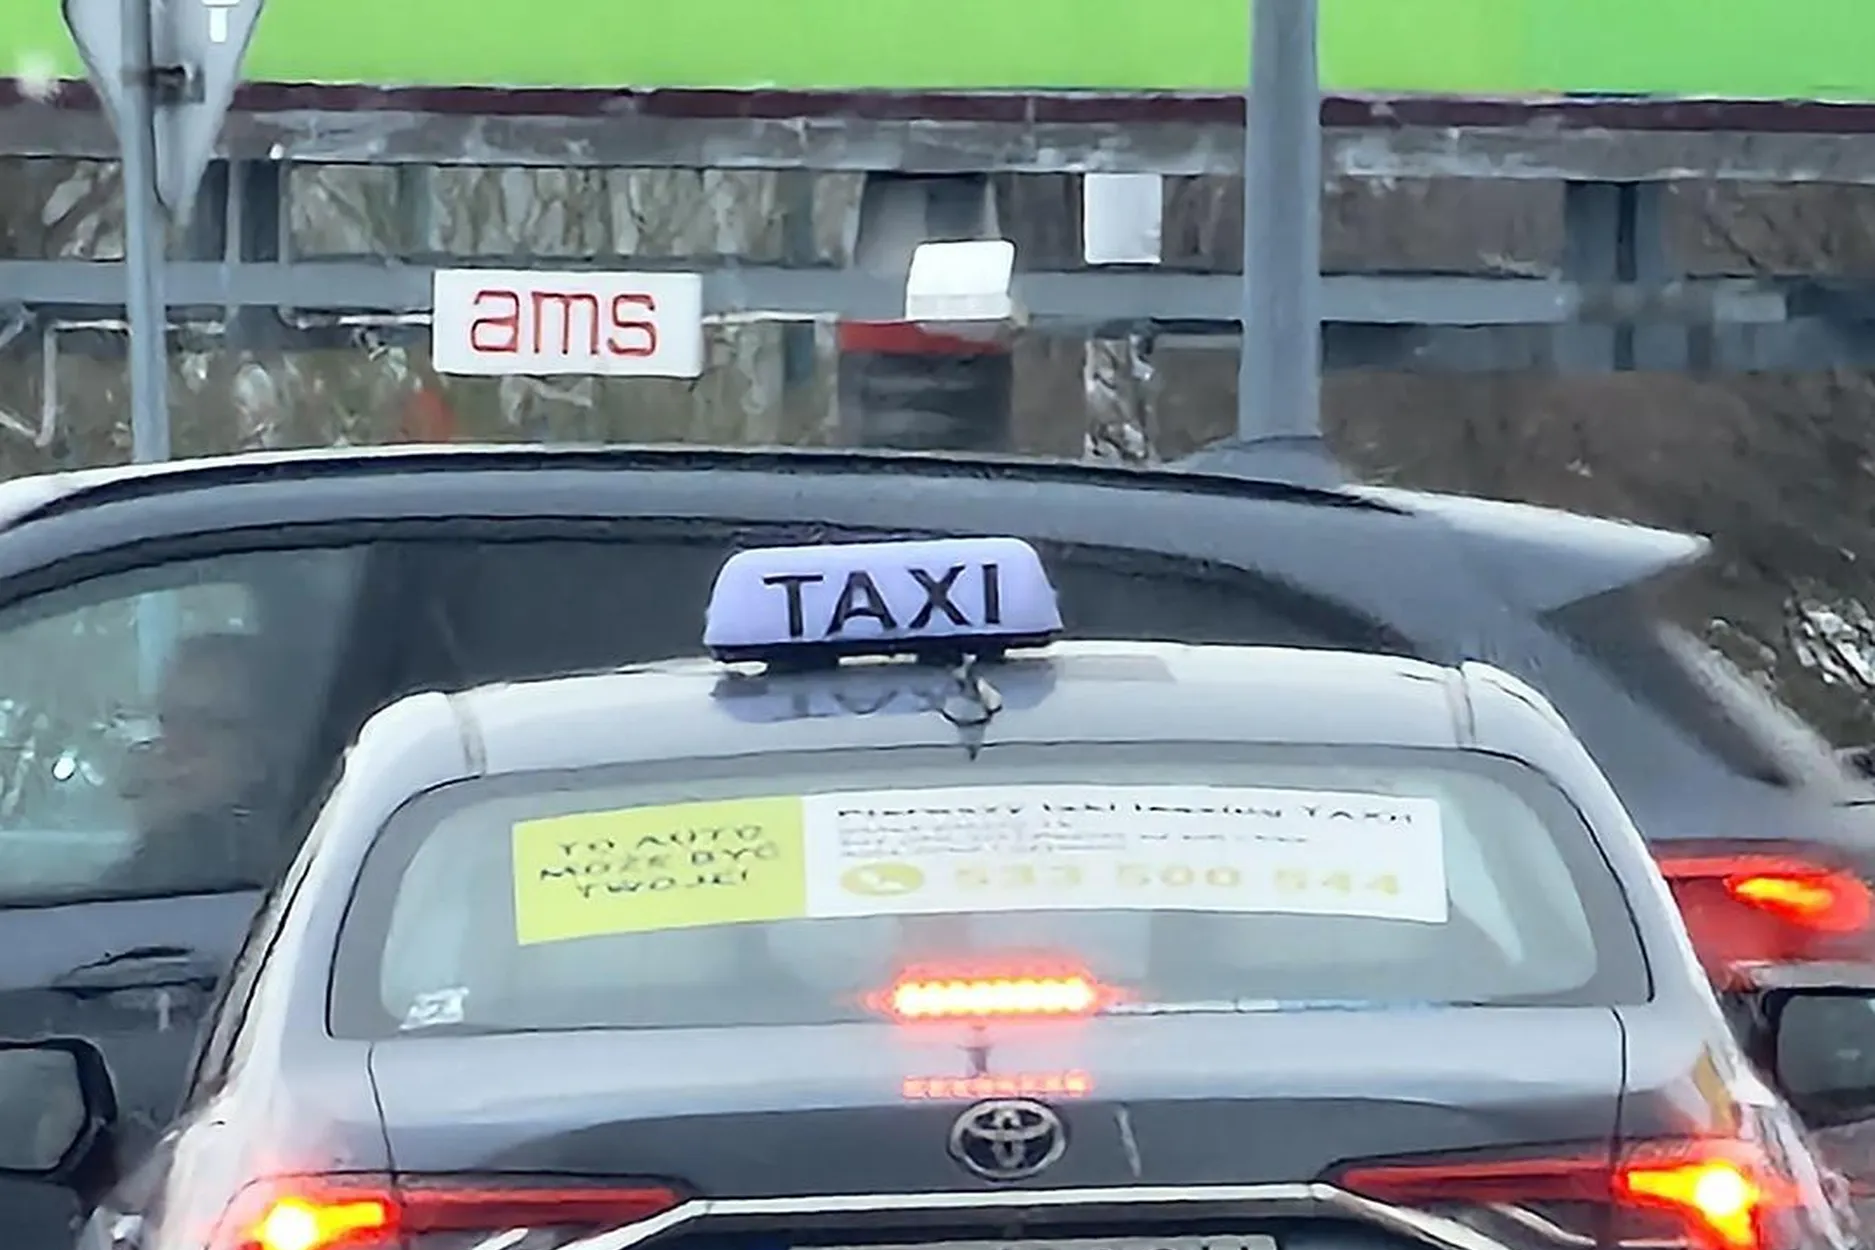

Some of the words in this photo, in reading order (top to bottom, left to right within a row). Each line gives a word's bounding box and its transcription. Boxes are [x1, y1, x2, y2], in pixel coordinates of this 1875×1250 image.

[470, 289, 658, 357] ams
[763, 563, 1001, 638] TAXI
[636, 825, 763, 849] AUTO
